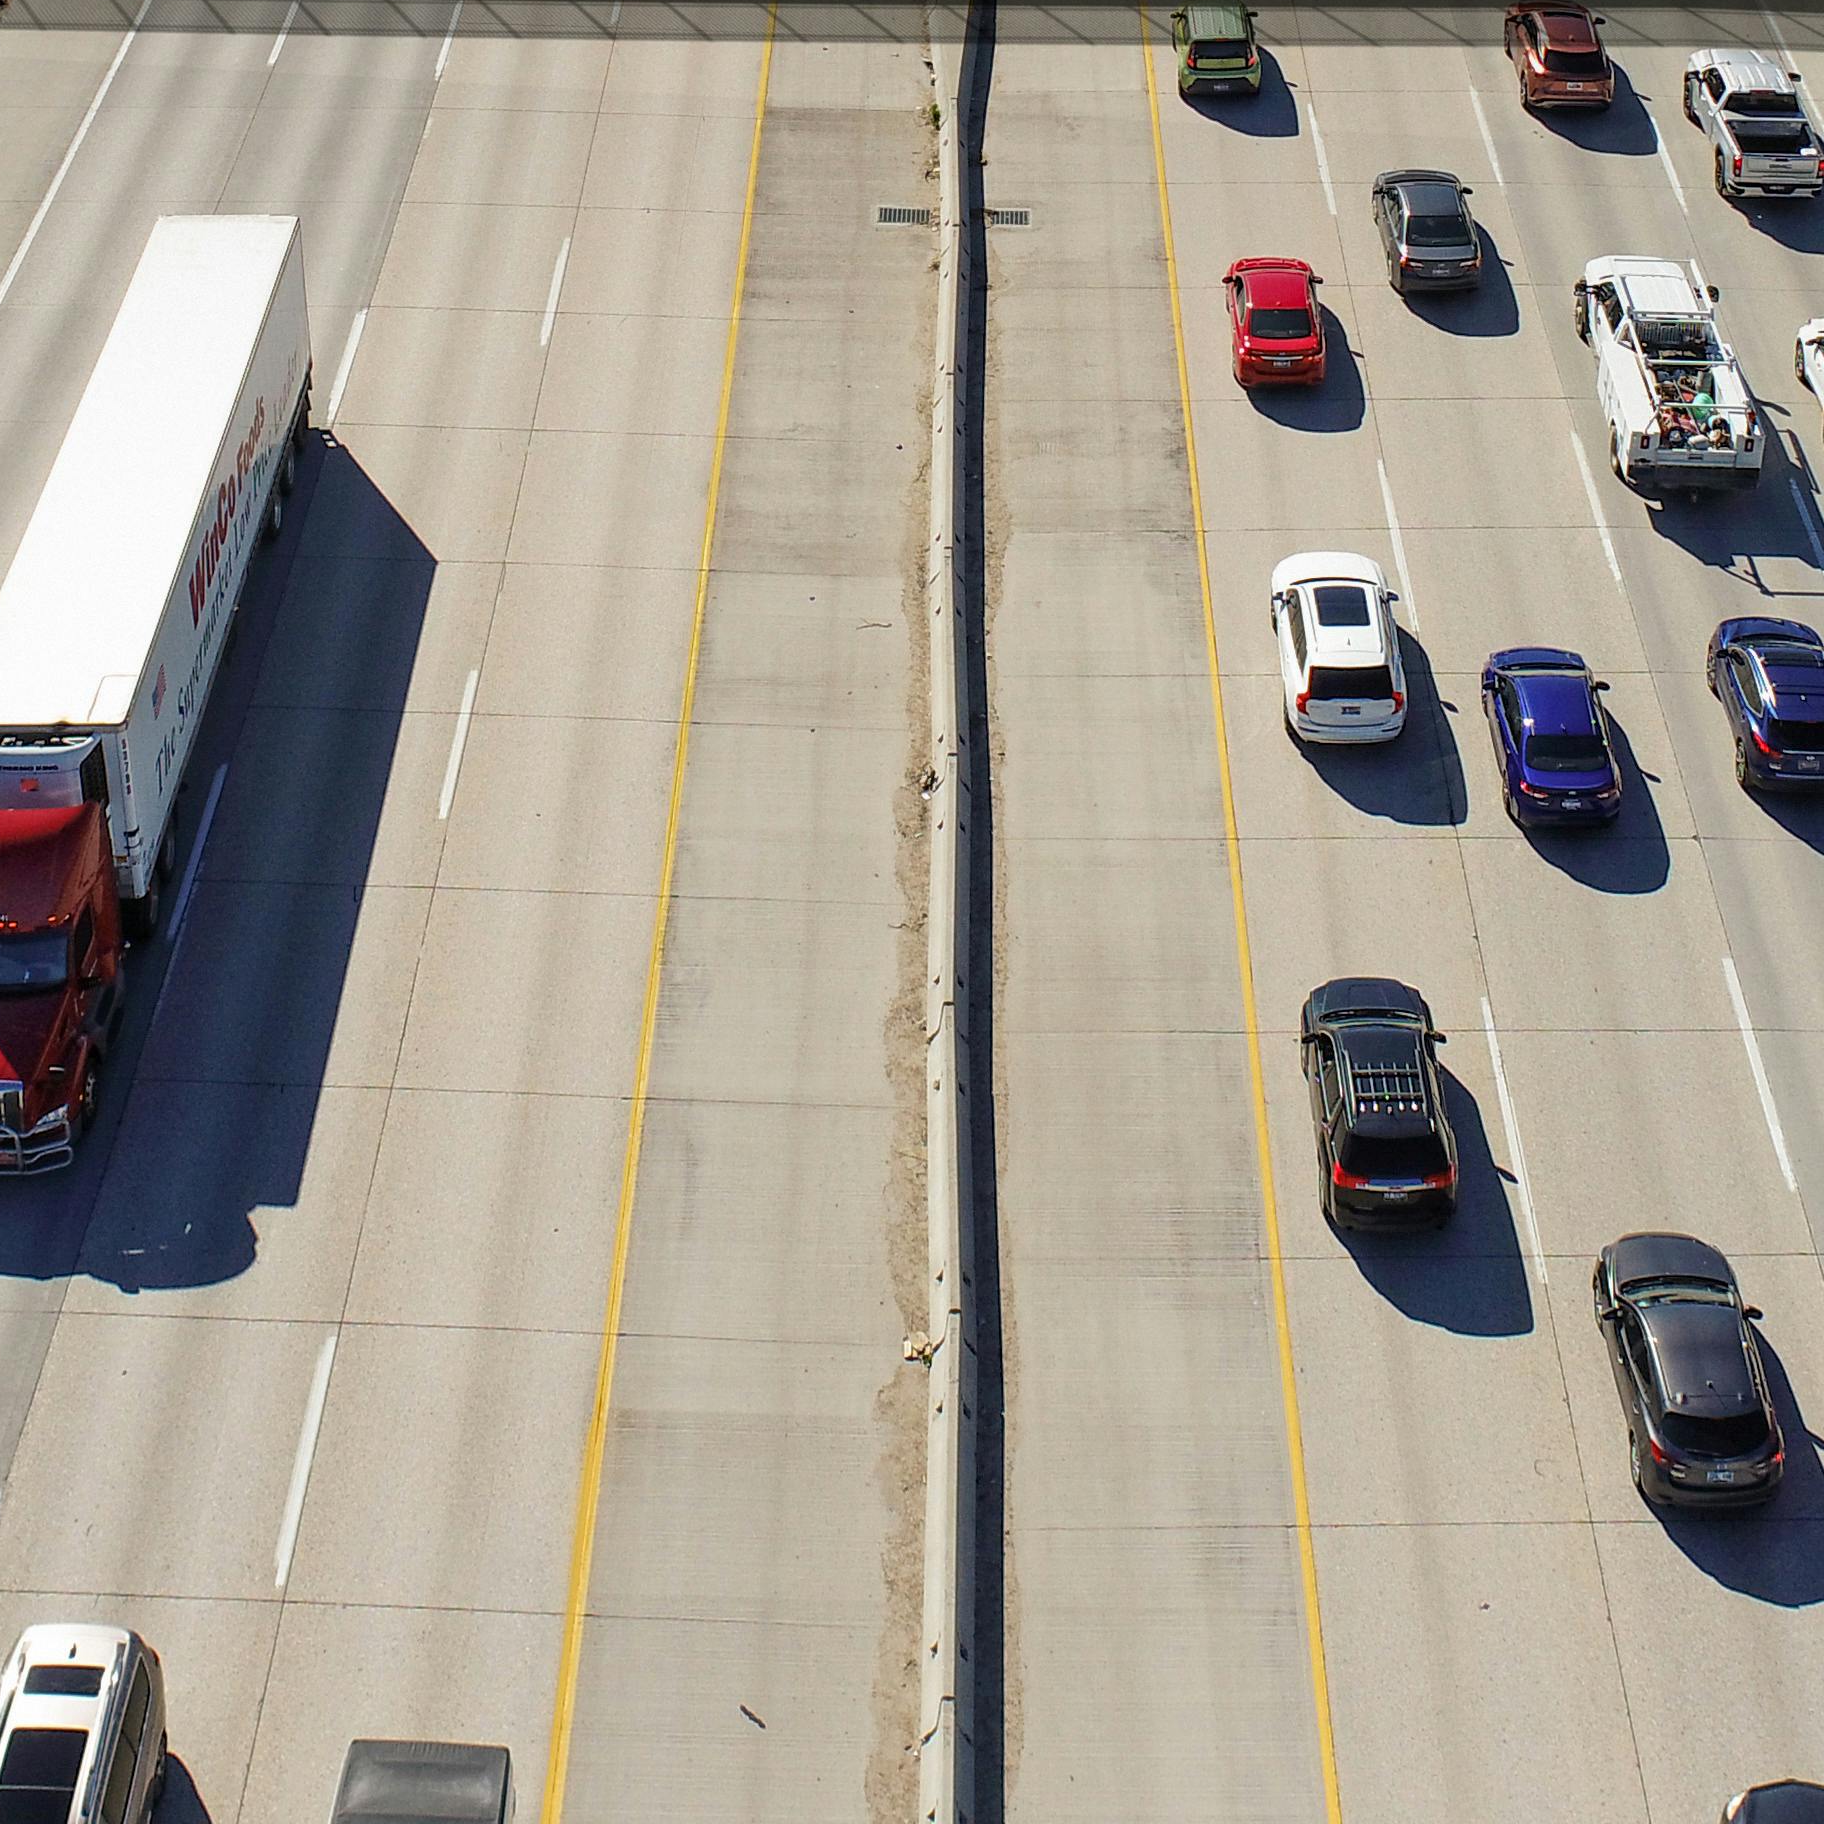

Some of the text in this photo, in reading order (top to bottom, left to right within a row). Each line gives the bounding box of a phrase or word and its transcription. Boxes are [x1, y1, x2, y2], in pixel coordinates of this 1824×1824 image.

[155, 726, 176, 796] The
[178, 547, 234, 734] Supermarket
[233, 491, 252, 558] Low
[189, 395, 264, 630] WinCo Foods
